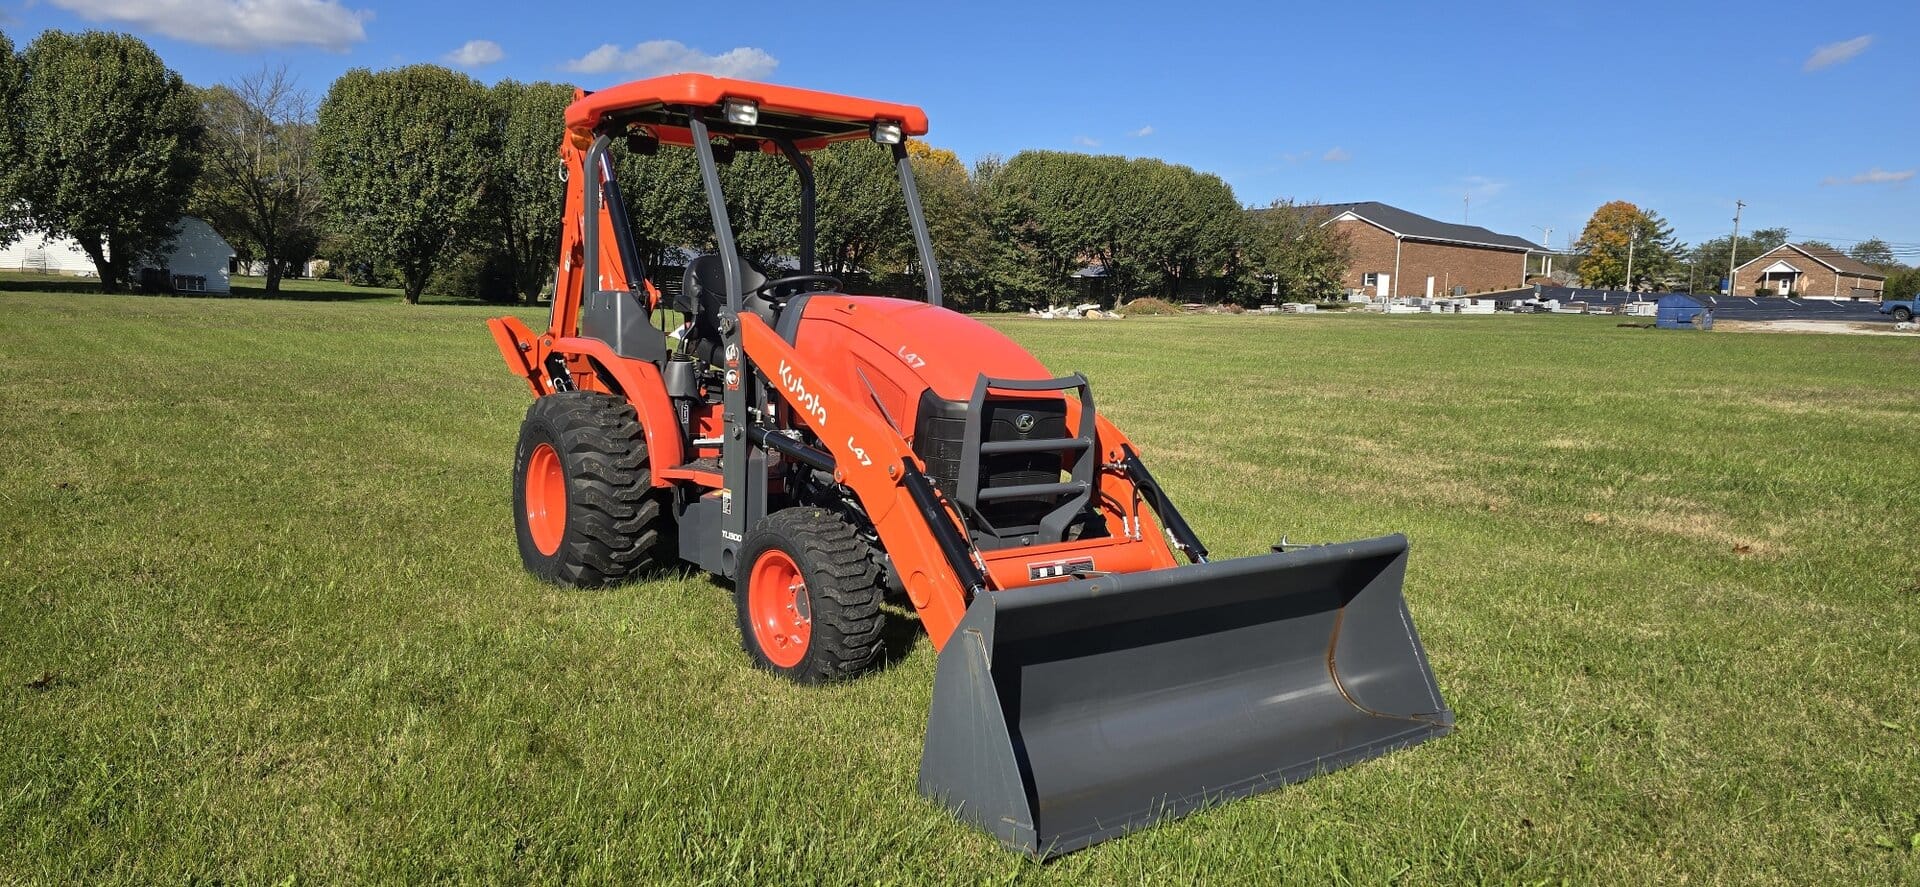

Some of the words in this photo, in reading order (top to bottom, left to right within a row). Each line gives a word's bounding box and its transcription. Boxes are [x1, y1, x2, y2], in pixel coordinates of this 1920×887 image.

[898, 345, 926, 369] L47
[779, 359, 827, 426] Kubota
[847, 435, 872, 466] L47
